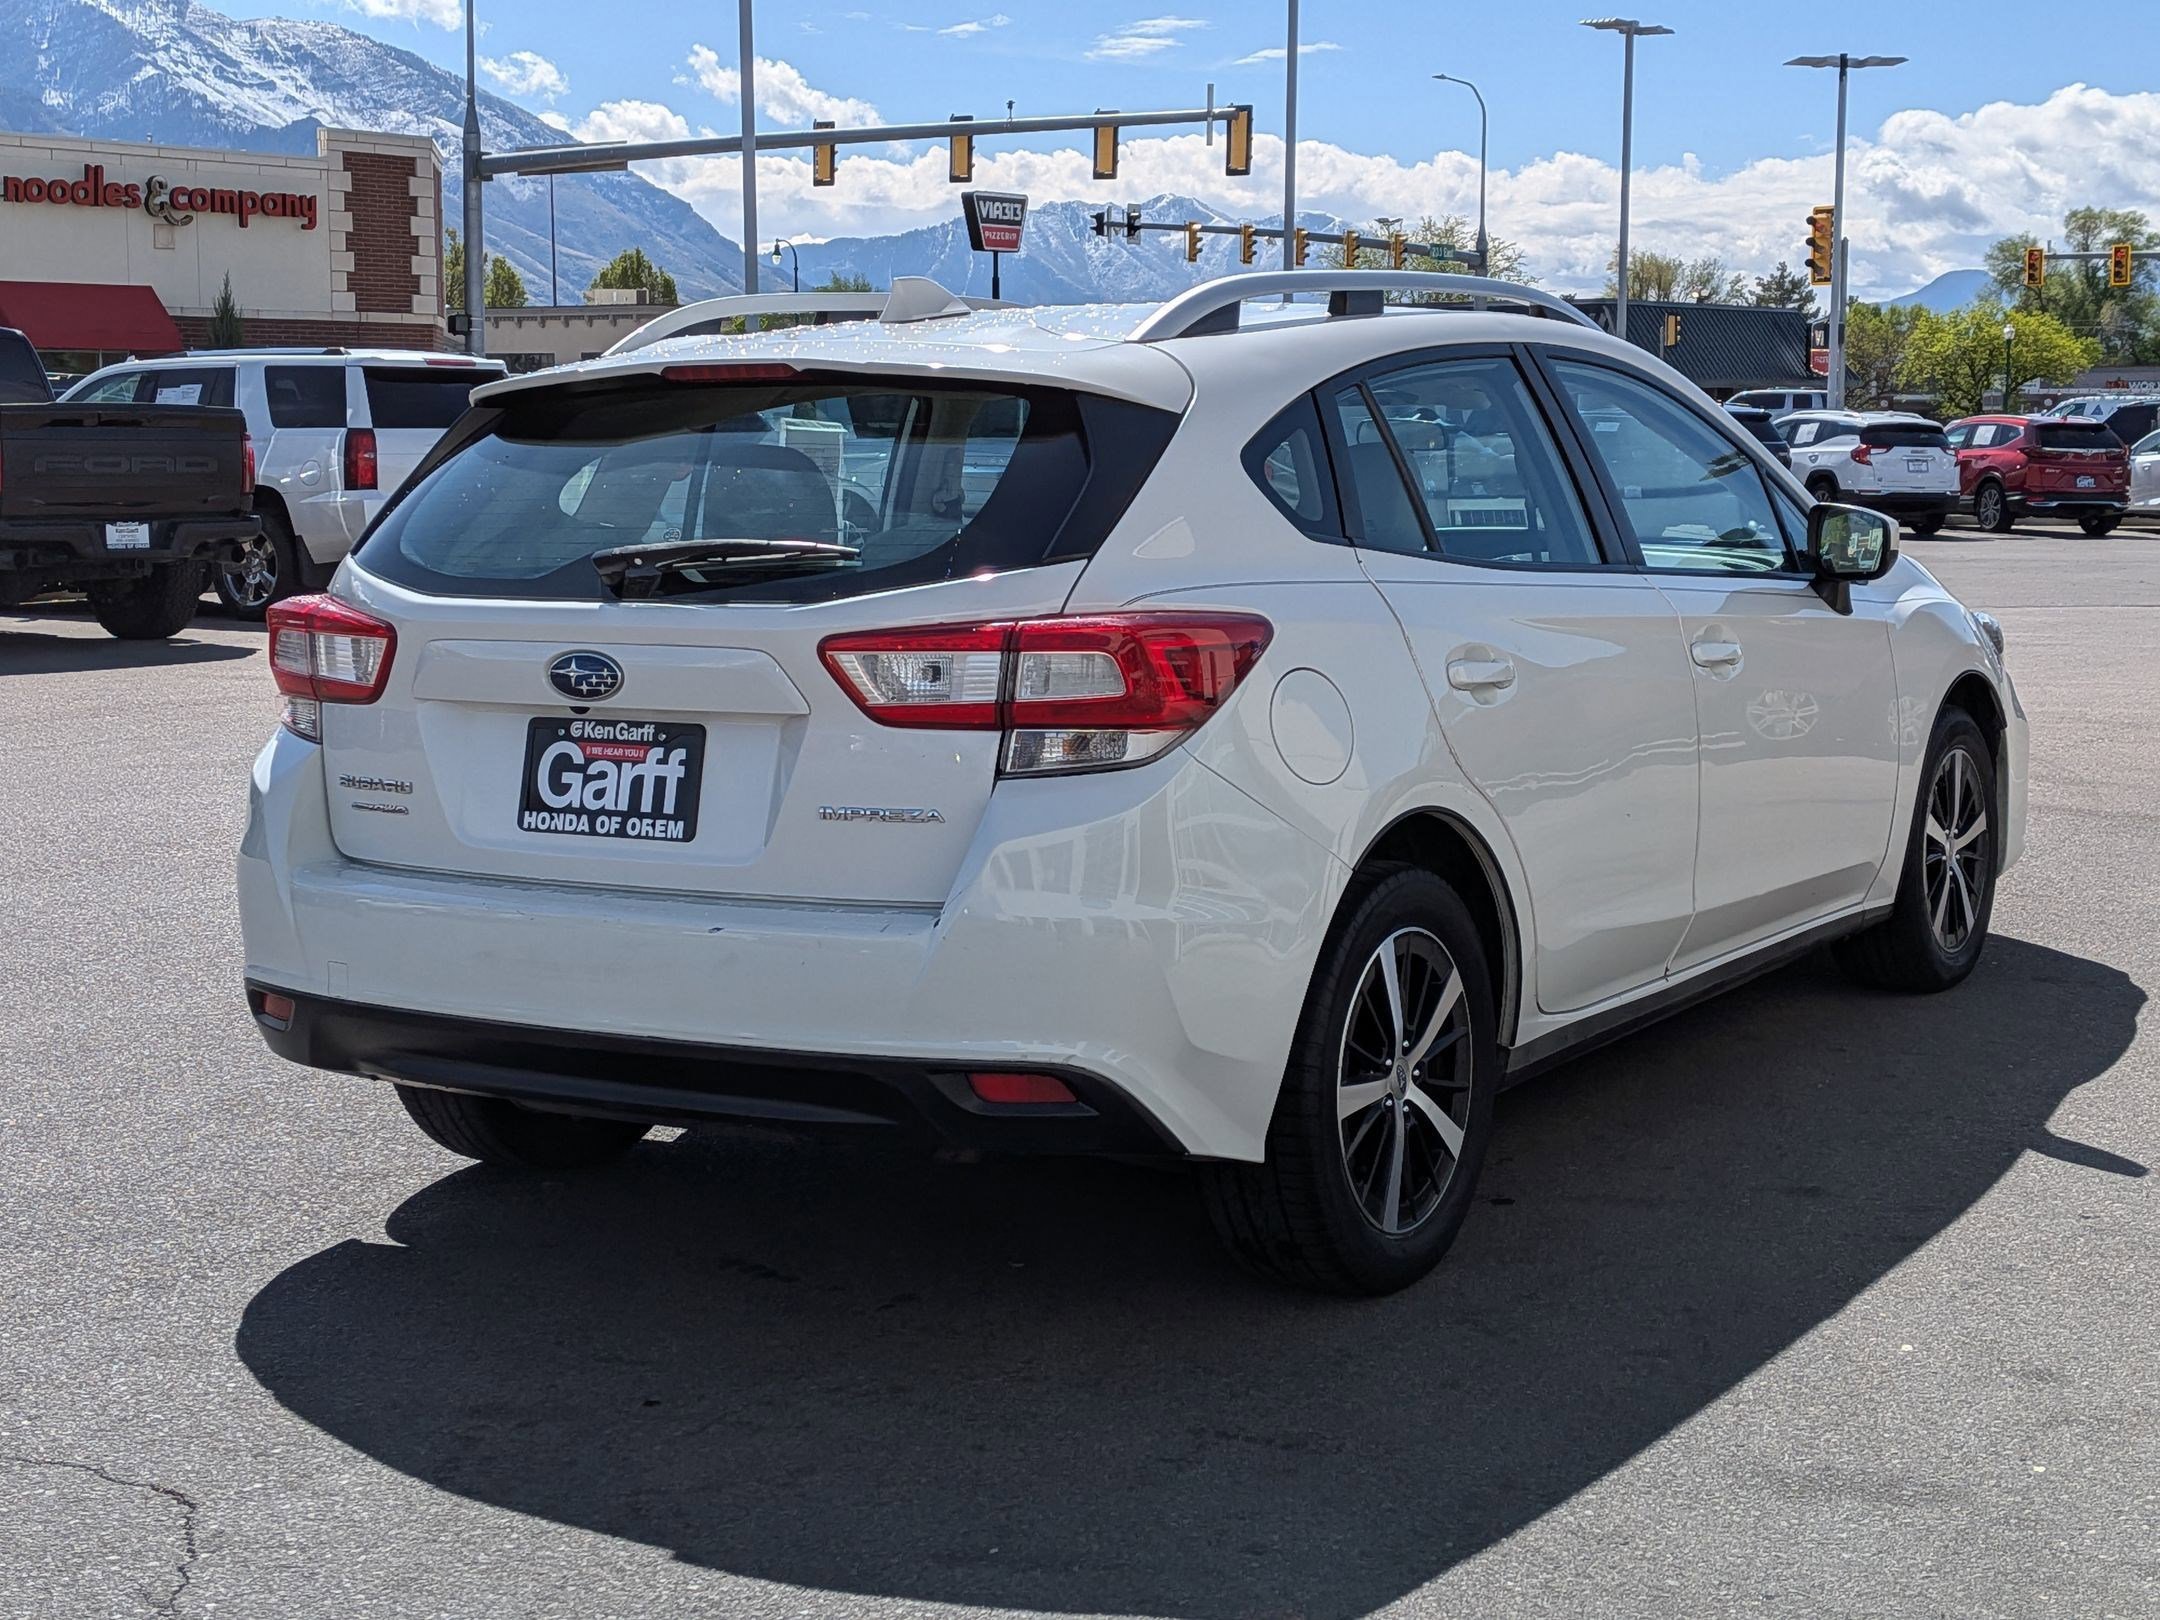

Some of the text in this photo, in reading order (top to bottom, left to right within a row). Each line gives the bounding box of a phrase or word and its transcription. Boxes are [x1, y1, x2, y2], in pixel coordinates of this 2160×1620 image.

[3, 163, 317, 230] noodles & company
[34, 455, 219, 473] FORD
[591, 746, 639, 758] WE HEAR YOU
[338, 773, 413, 794] SUBARU
[537, 740, 687, 815] Garff
[523, 811, 684, 839] HONDA OF OREM
[818, 806, 946, 823] IMPREZA
